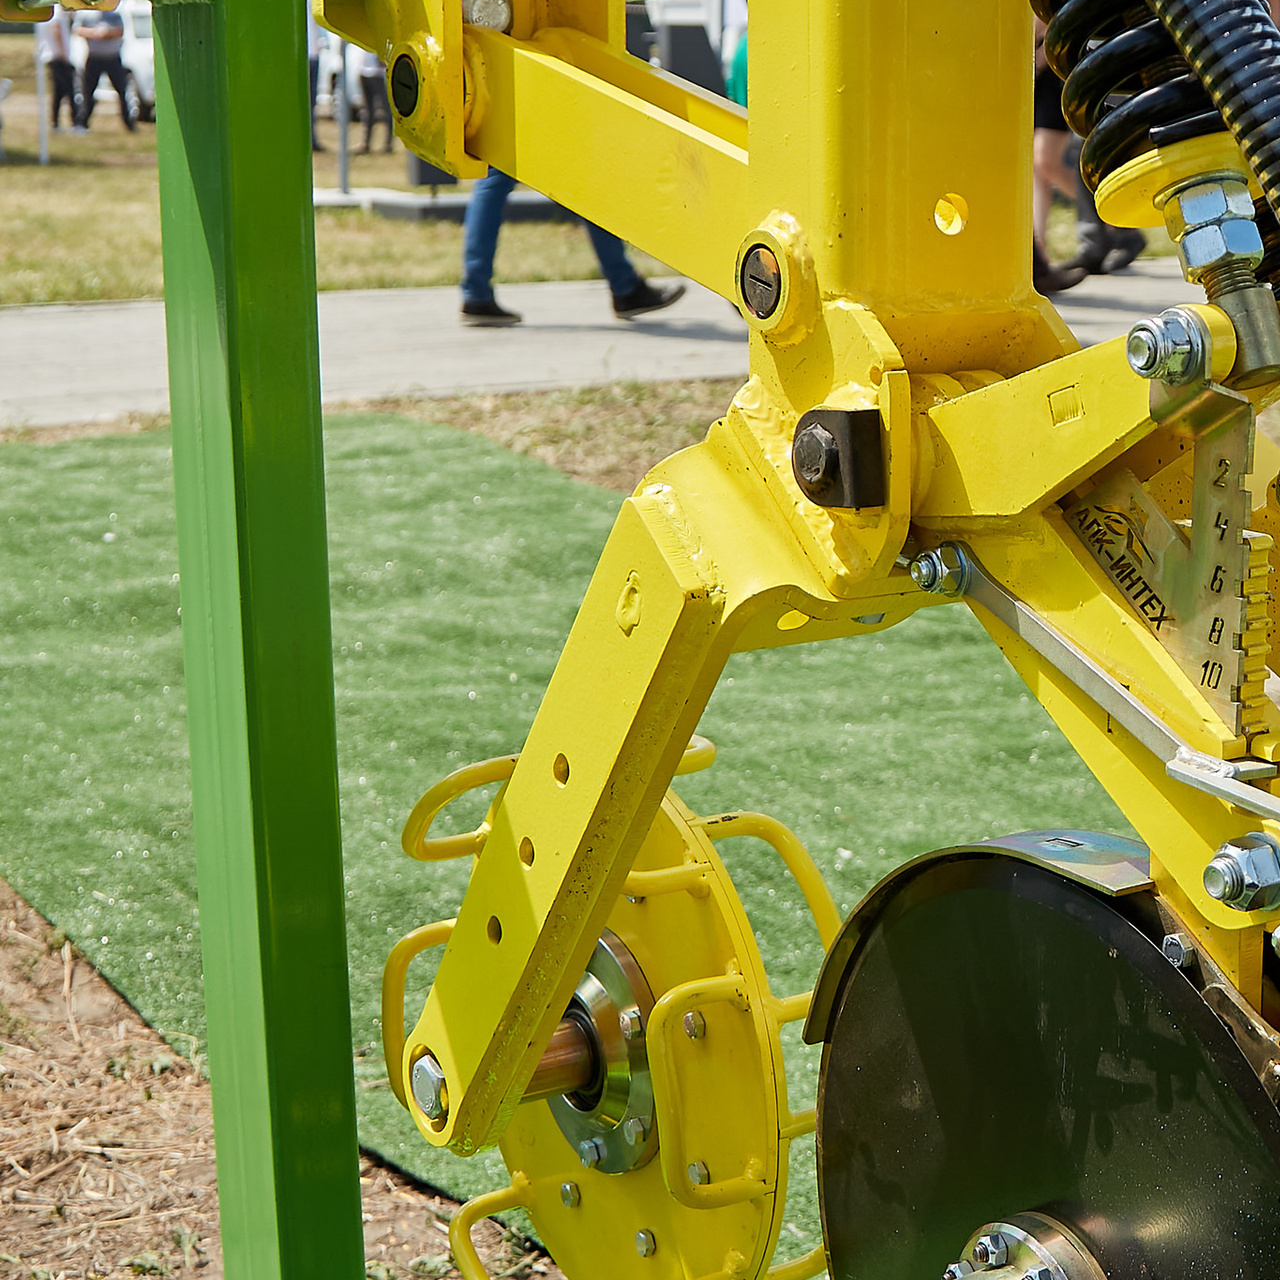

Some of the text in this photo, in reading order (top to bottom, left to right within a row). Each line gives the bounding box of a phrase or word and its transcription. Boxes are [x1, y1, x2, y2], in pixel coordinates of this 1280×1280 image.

[1213, 459, 1231, 488] 2
[1214, 511, 1229, 541] 4
[1074, 508, 1176, 631] АПК-ИНТЕХ
[1210, 565, 1227, 594] 6
[1208, 616, 1225, 646] 8
[1200, 660, 1223, 690] 10
